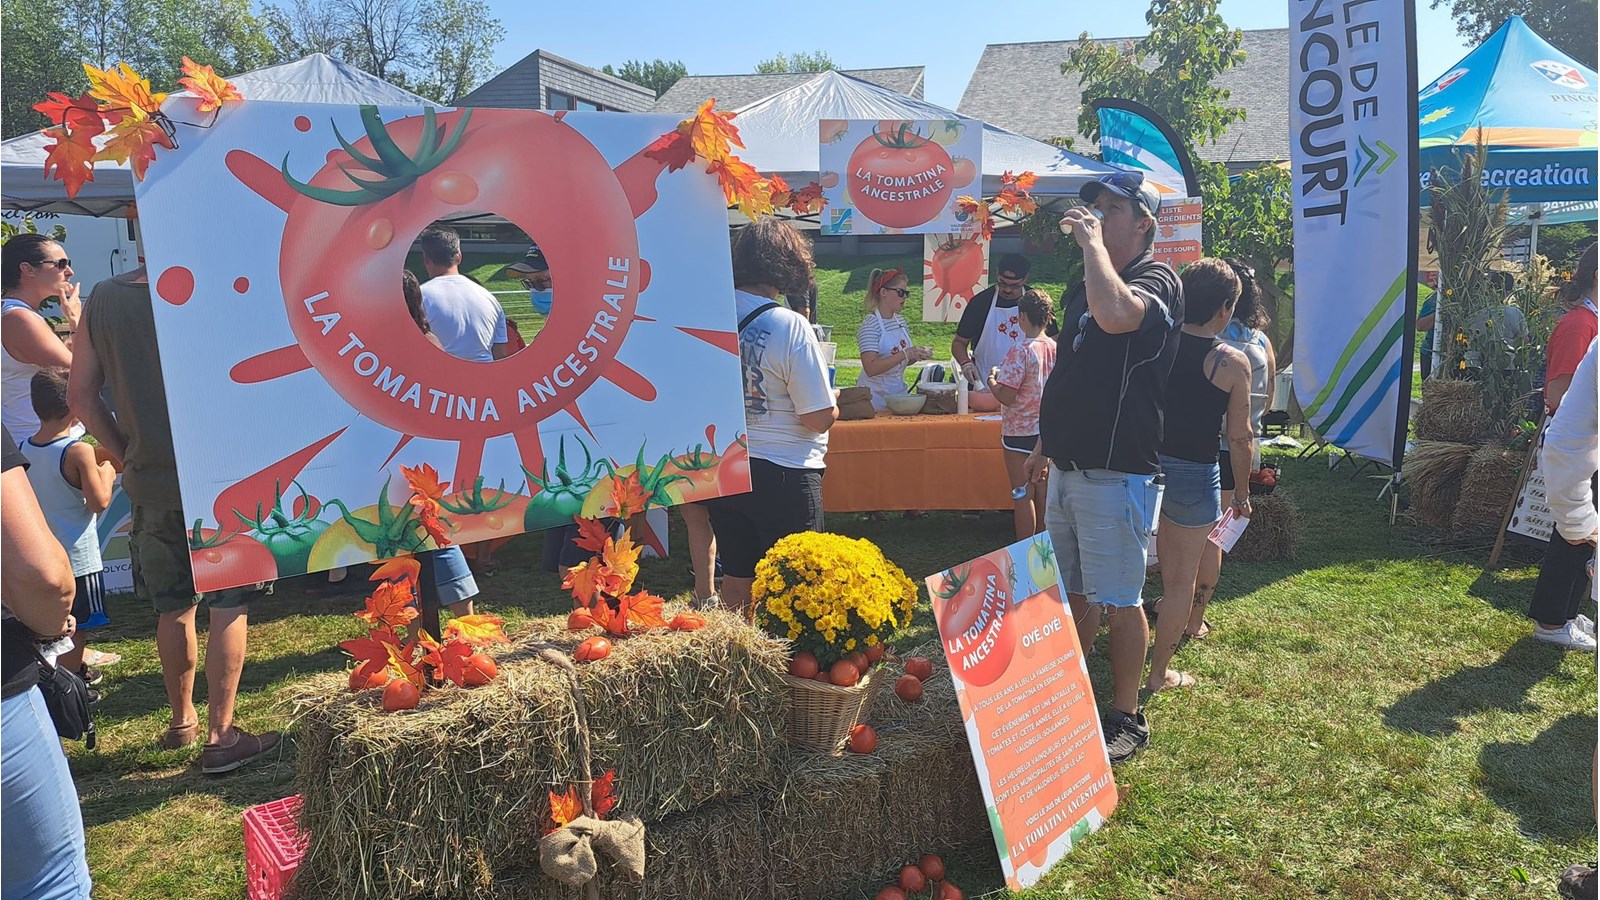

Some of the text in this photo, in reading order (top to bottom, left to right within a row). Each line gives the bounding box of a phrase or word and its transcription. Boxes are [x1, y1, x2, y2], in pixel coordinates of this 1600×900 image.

[1350, 62, 1379, 121] DE
[856, 164, 946, 187] LA TOMATINA
[861, 179, 945, 201] ANCESTRALE
[1158, 213, 1202, 222] GRÉDIENTS
[304, 256, 630, 422] LA TOMATINA ANCESTRALE
[948, 574, 996, 655] LA TOMATINA
[962, 590, 1006, 671] ANCESTRALE
[1023, 618, 1061, 647] OYÉ, OYÉ!
[978, 697, 993, 708] TOUS
[993, 691, 1003, 701] LES
[1004, 685, 1014, 695] ANS
[1019, 677, 1030, 687] LIEU
[1030, 673, 1036, 681] LA
[996, 705, 1004, 714] DE
[1011, 687, 1036, 704] TOMATINA
[987, 737, 1012, 756] TOMATES
[1020, 723, 1035, 736] CETTE
[1052, 705, 1063, 716] ELLE
[992, 728, 1001, 739] CET
[1032, 704, 1041, 715] EST
[1041, 698, 1051, 709] UNE
[995, 790, 1009, 804] SONT
[1010, 783, 1020, 794] LES
[1055, 754, 1062, 763] DE
[997, 777, 1007, 788] LES
[1007, 761, 1031, 781] HEUREUX
[1031, 740, 1061, 764] VAINQUEURS
[1061, 736, 1068, 745] DE
[1012, 774, 1109, 857] LA TOMATINA ANCESTRALE
[1019, 794, 1025, 803] ET
[1026, 789, 1034, 798] DE
[1026, 813, 1040, 826] VOICI
[1039, 808, 1046, 817] LE
[1045, 801, 1055, 812] JUS
[1055, 796, 1061, 805] DE
